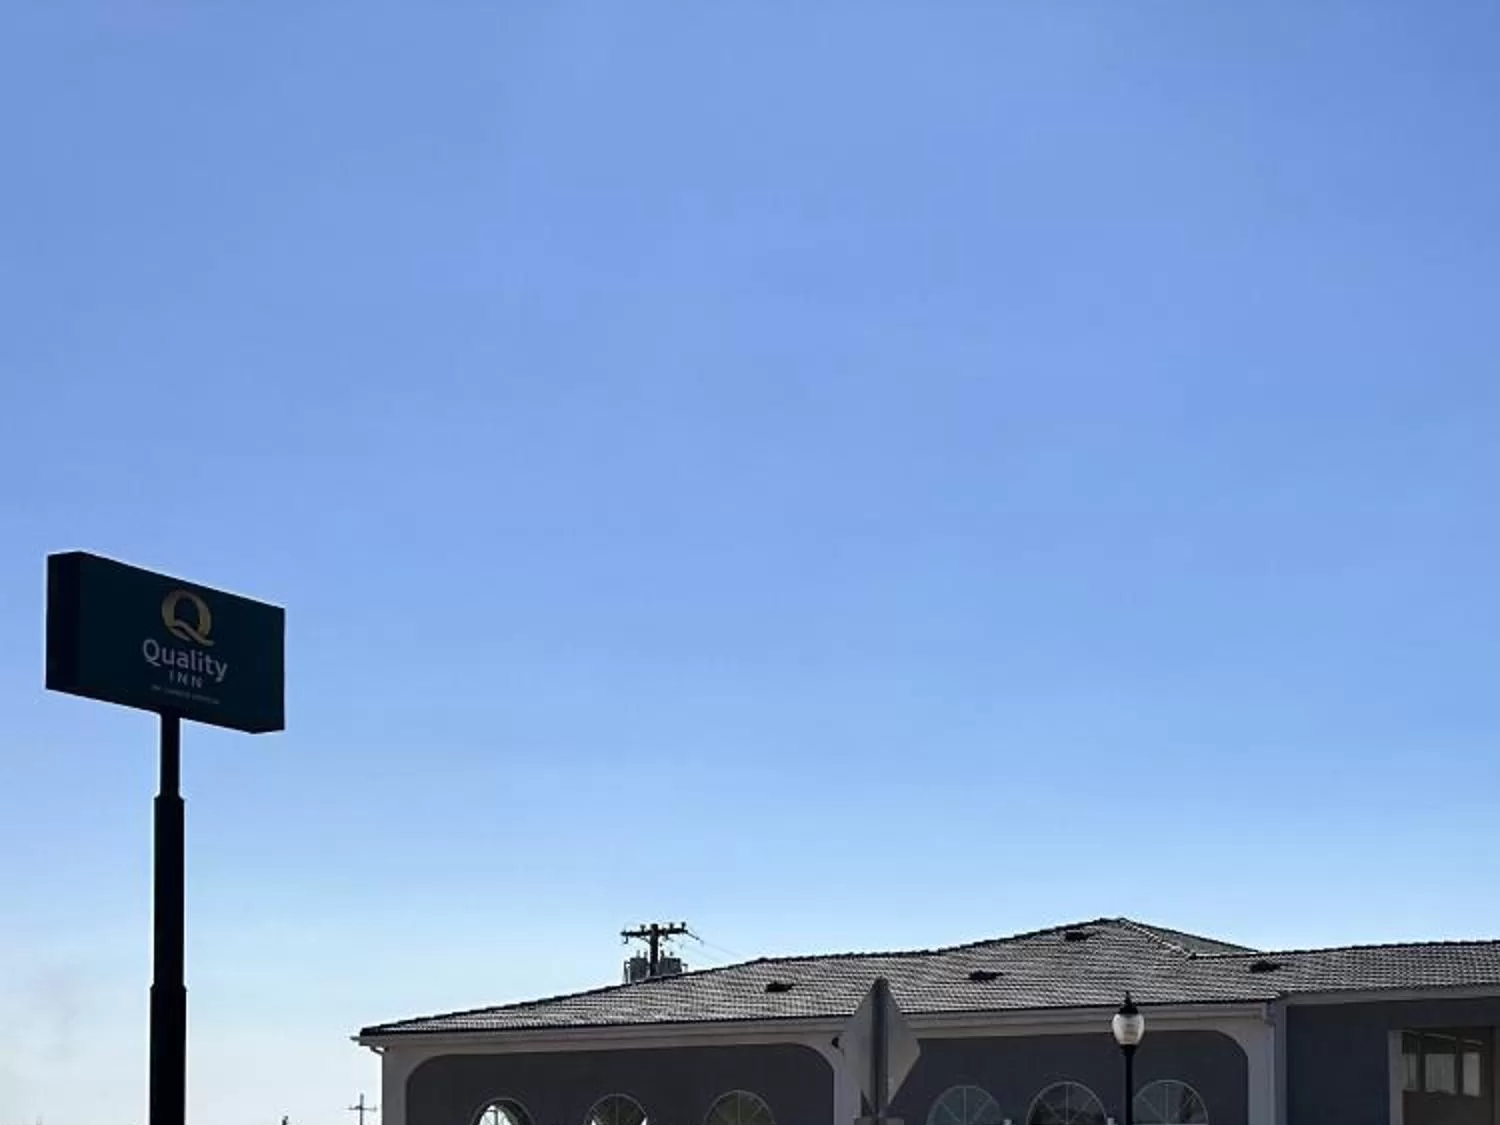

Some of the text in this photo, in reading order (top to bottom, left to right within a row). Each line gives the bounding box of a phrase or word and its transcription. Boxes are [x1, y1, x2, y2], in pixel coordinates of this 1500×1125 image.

[161, 588, 215, 647] Q
[143, 638, 228, 682] Quality
[168, 669, 204, 689] INN
